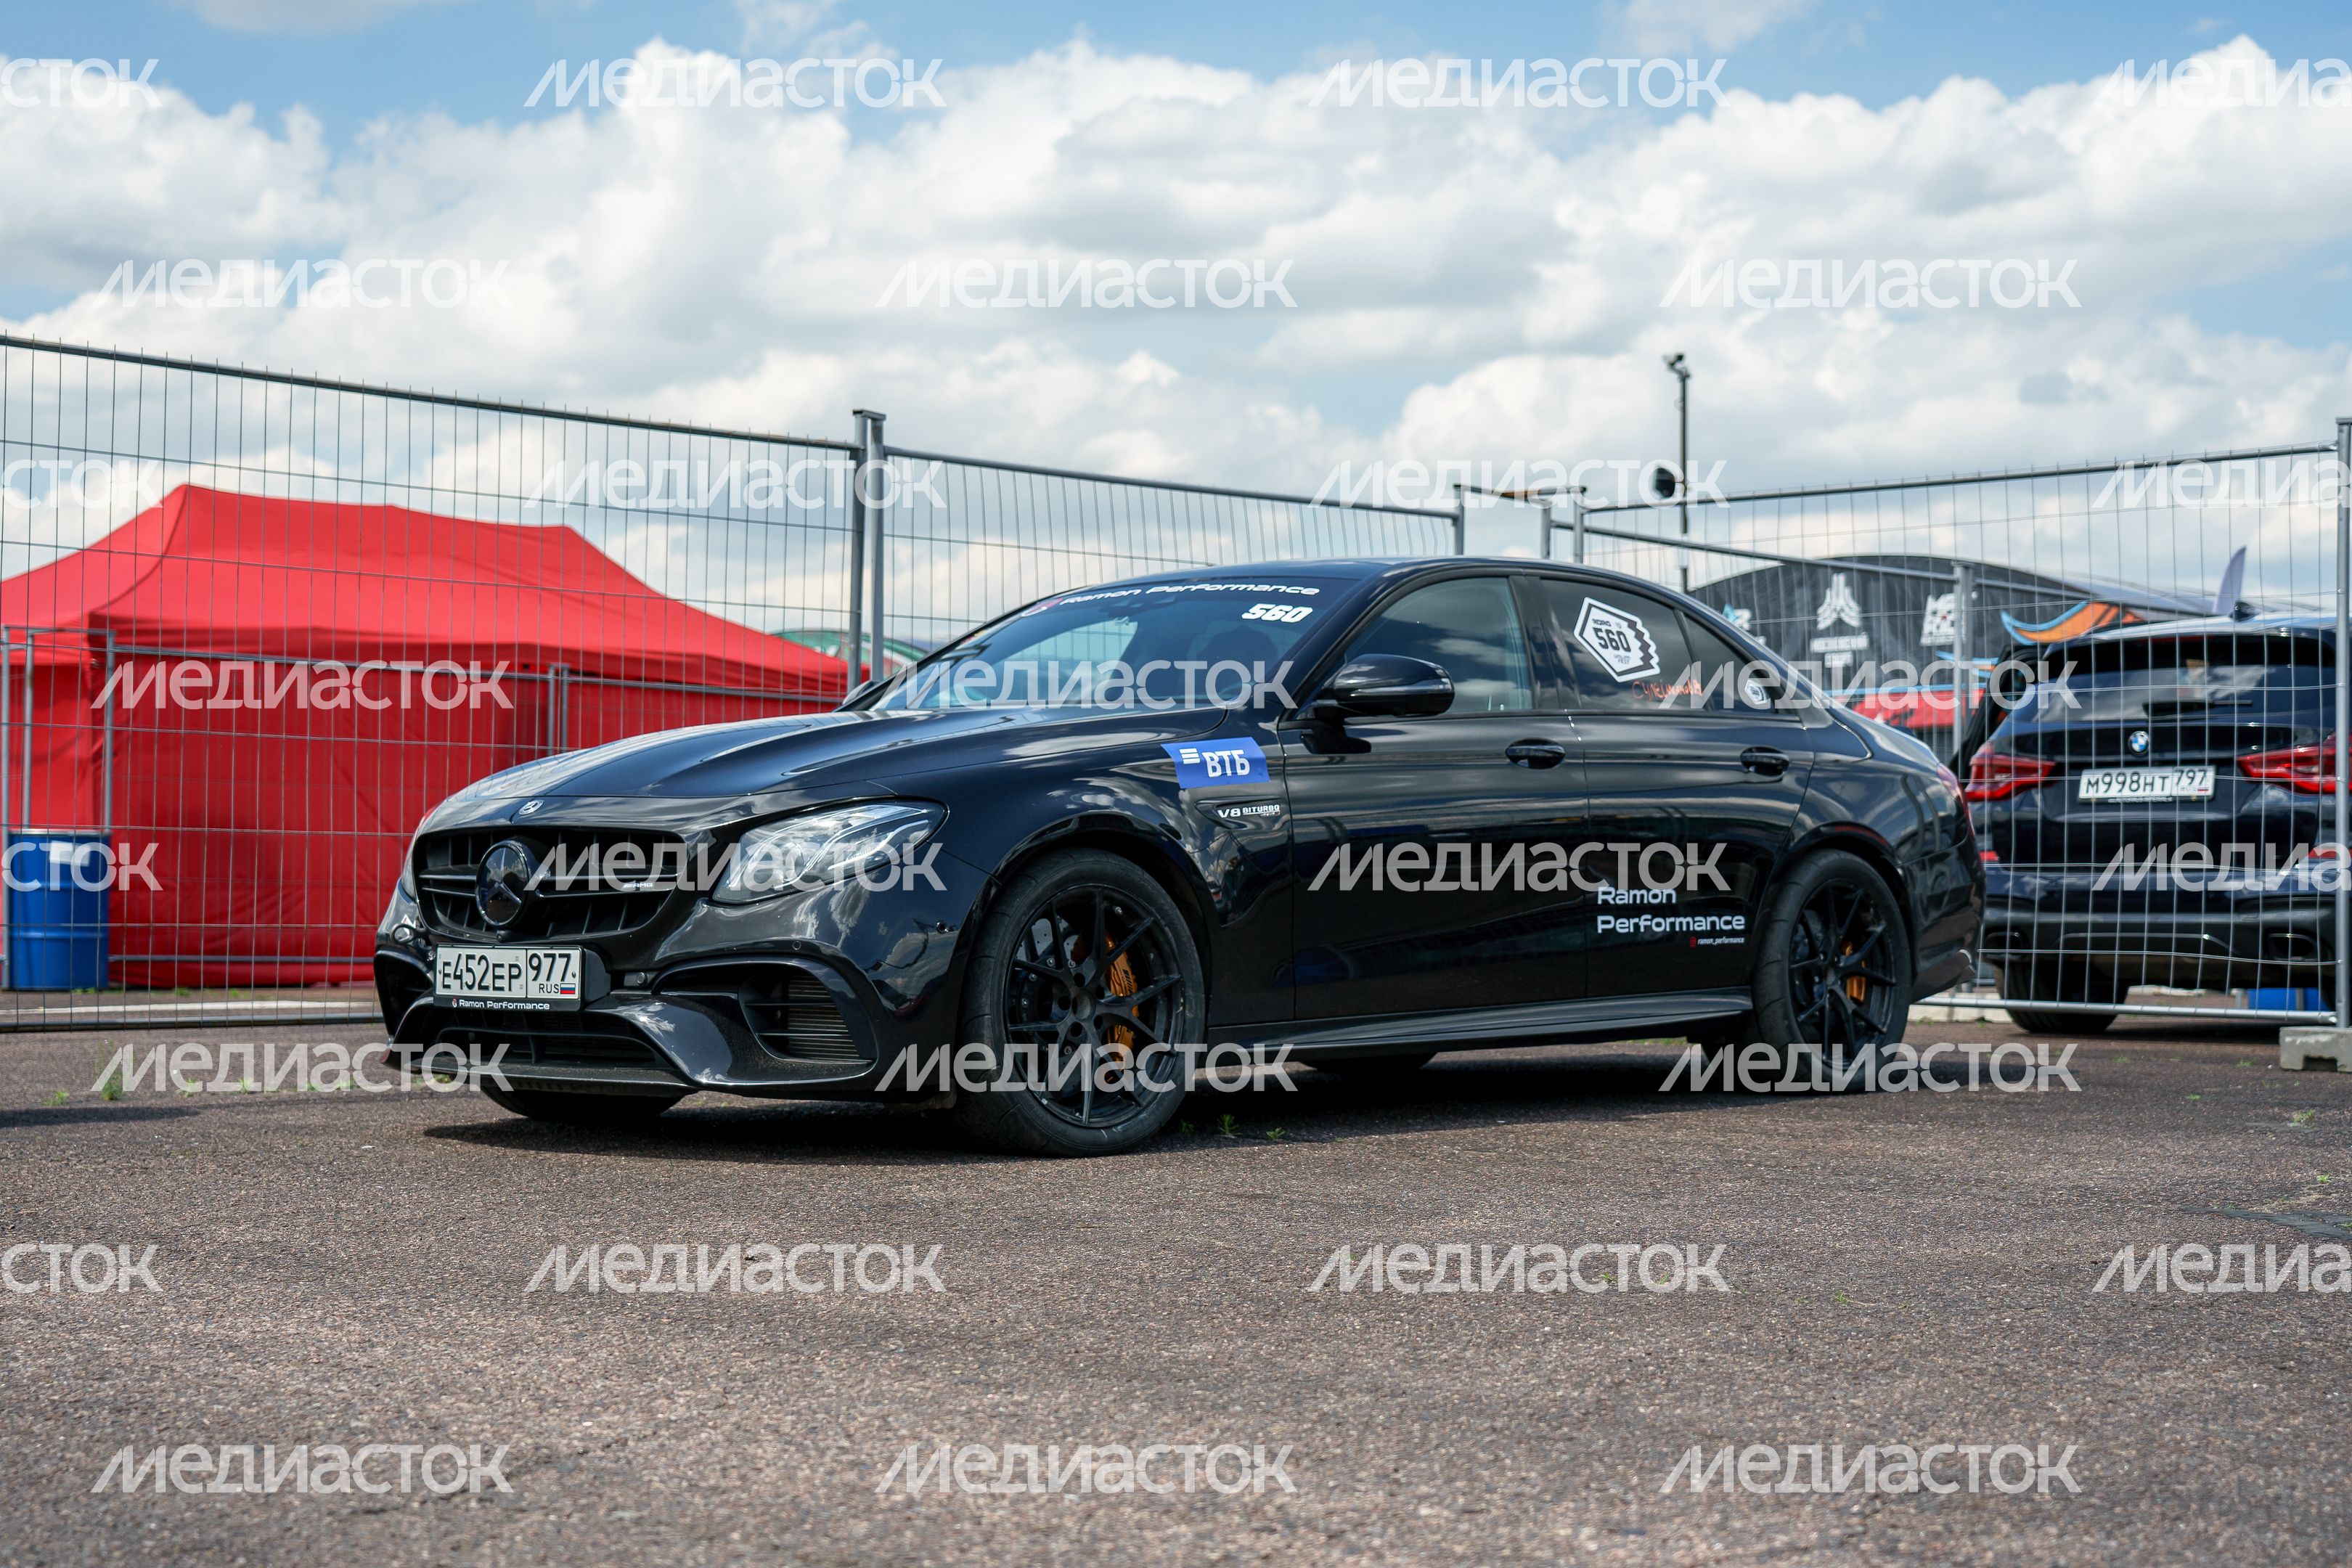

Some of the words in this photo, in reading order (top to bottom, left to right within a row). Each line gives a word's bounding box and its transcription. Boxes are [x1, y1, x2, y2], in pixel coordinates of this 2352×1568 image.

[1059, 588, 1143, 605] Ramon
[1146, 583, 1320, 595] Performance
[1241, 603, 1314, 624] 560
[1592, 626, 1631, 653] 560
[1202, 749, 1250, 777] ВТБ
[2174, 769, 2208, 786] 797
[1217, 808, 1241, 818] V8
[1242, 804, 1280, 814] BITURBO
[1597, 886, 1677, 905] Ramon
[1597, 915, 1745, 934] Performance
[442, 953, 523, 992] Е452ЕР
[528, 952, 572, 982] 977
[539, 983, 560, 995] RUS
[460, 999, 485, 1008] Ramon
[487, 1001, 550, 1010] Performance
